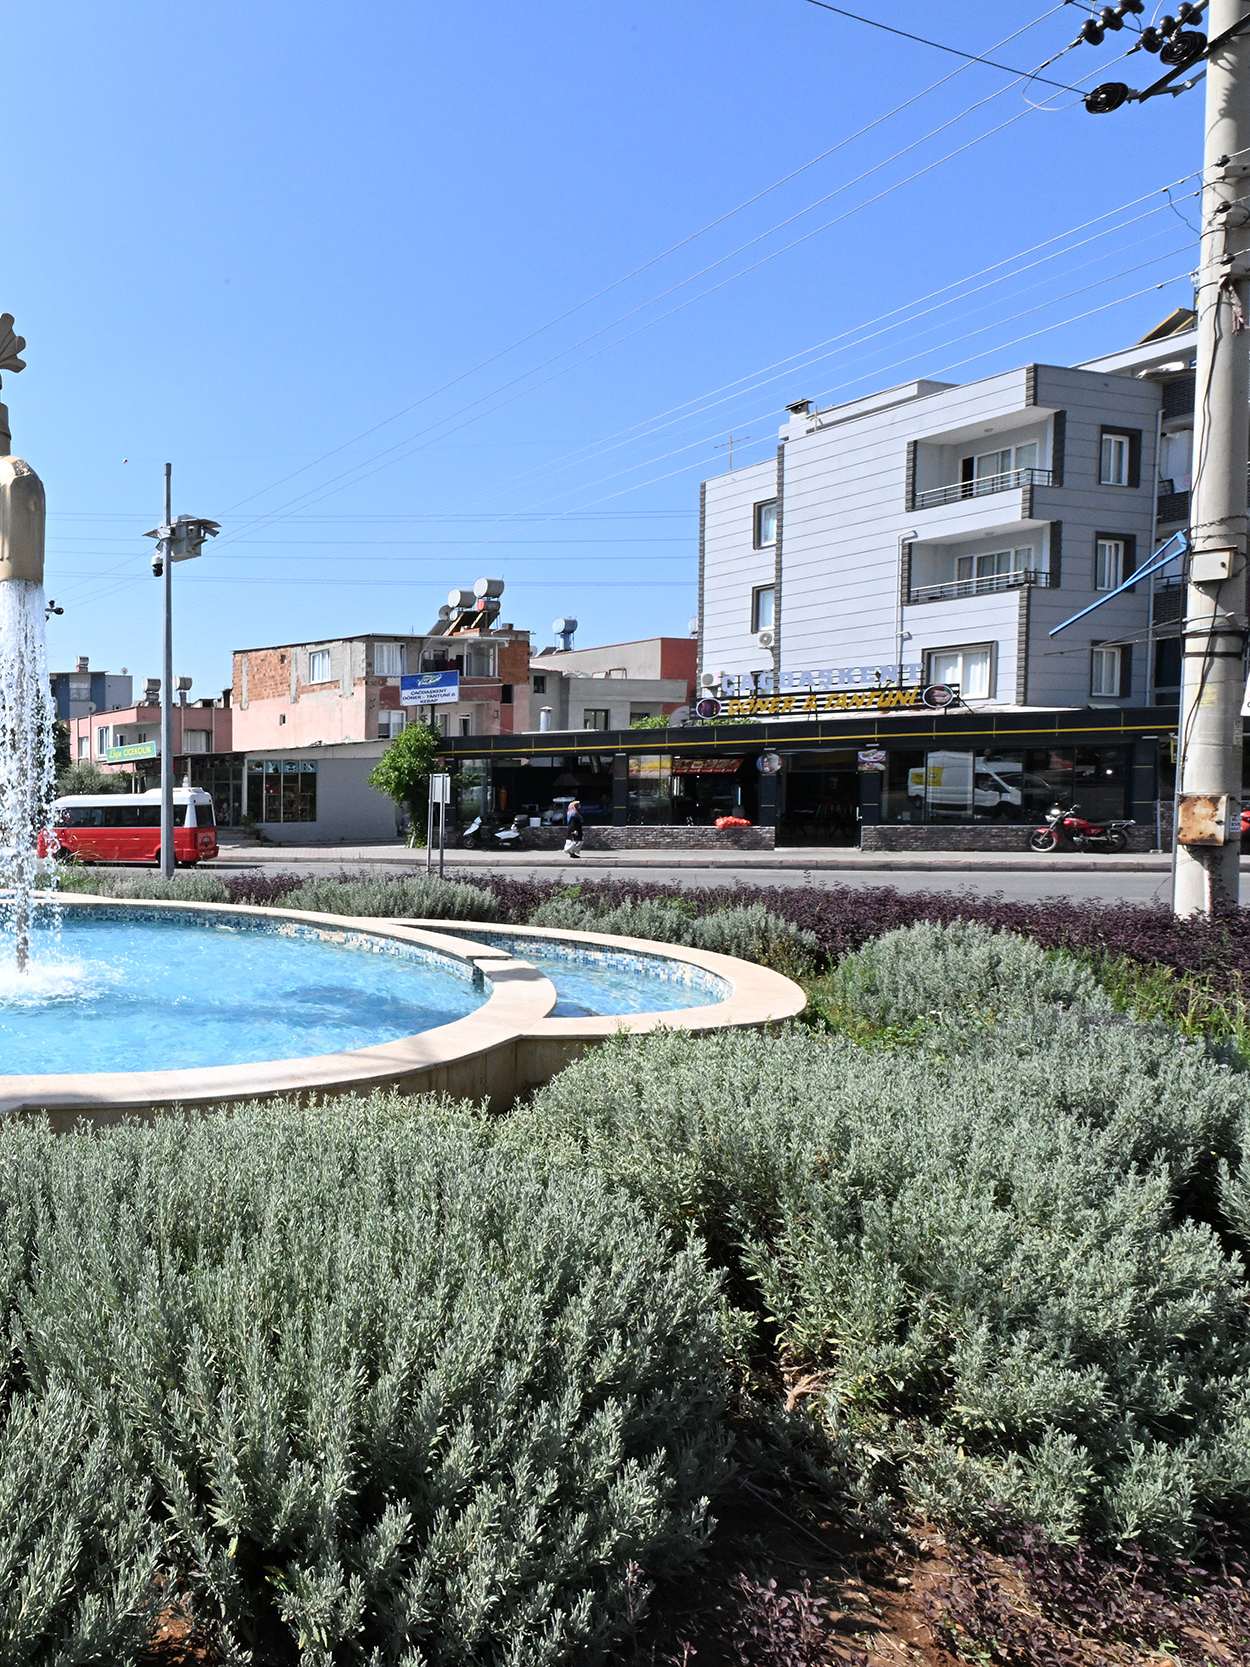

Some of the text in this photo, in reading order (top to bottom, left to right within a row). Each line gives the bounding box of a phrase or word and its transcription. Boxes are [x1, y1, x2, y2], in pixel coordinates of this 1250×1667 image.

[722, 664, 923, 695] ÇAĞDAŞKENT
[727, 685, 919, 716] DÖNER & TANTUNİ
